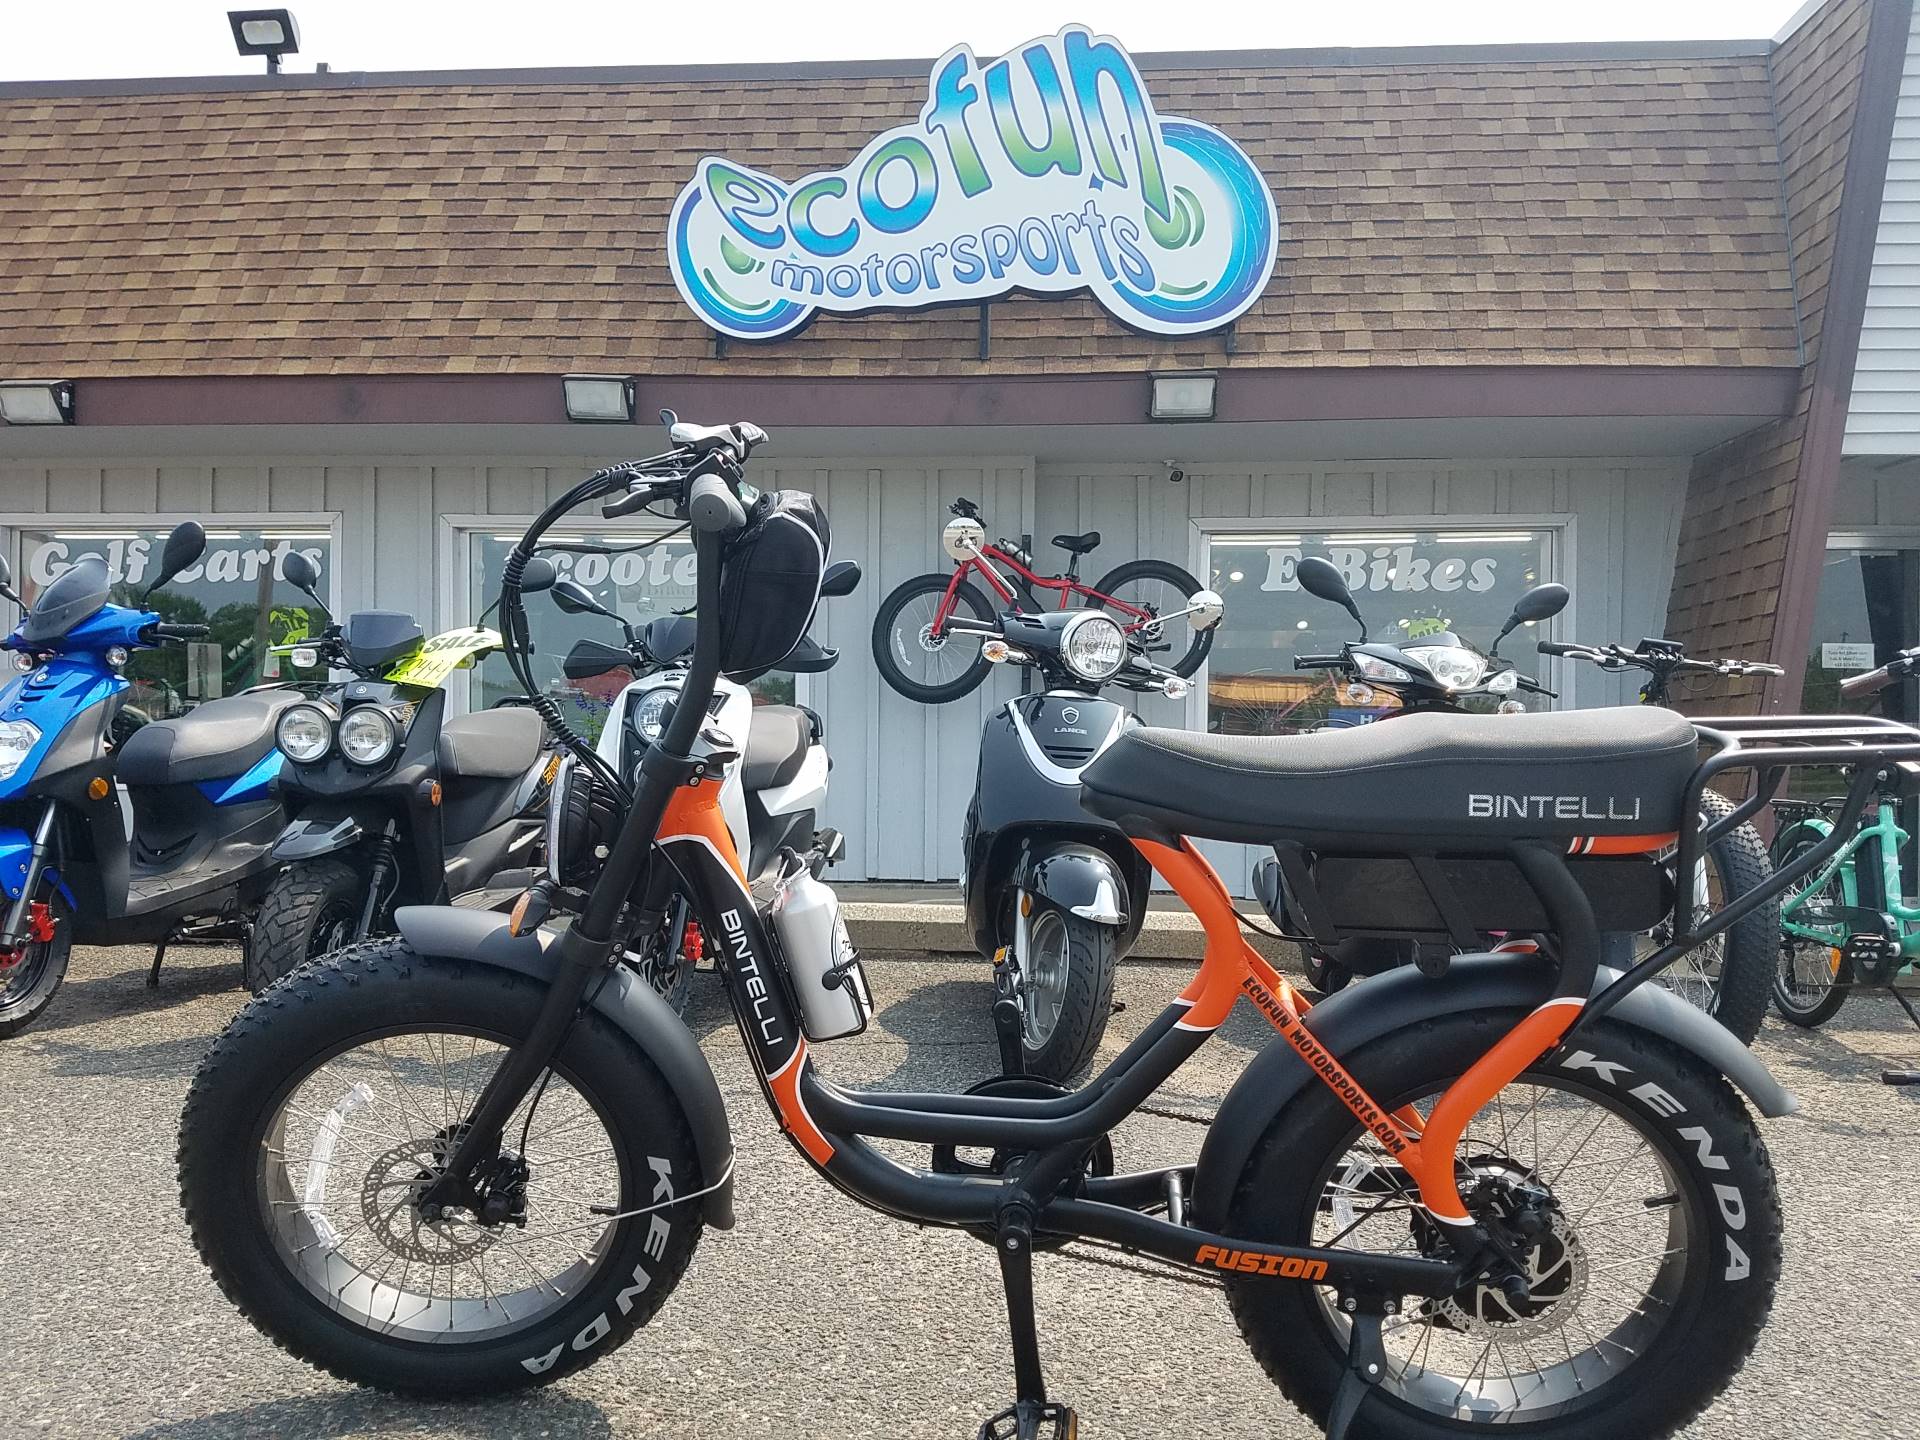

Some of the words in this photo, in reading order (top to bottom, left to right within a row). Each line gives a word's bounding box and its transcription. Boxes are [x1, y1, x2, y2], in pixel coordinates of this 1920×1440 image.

[706, 30, 1172, 257] ecofun
[770, 199, 1157, 299] motorsports
[30, 539, 151, 587] Glf
[423, 635, 492, 654] SALE
[1054, 727, 1088, 736] LANCE
[1468, 793, 1641, 821] BINTELLI
[720, 908, 783, 1046] BINTELLI
[1242, 975, 1293, 1029] ECOFUN
[1289, 1029, 1408, 1155] MOTORSPORTS.COM
[1561, 1049, 1752, 1283] KENDA
[520, 1155, 674, 1375] KENDA
[1194, 1244, 1329, 1281] FUSION
